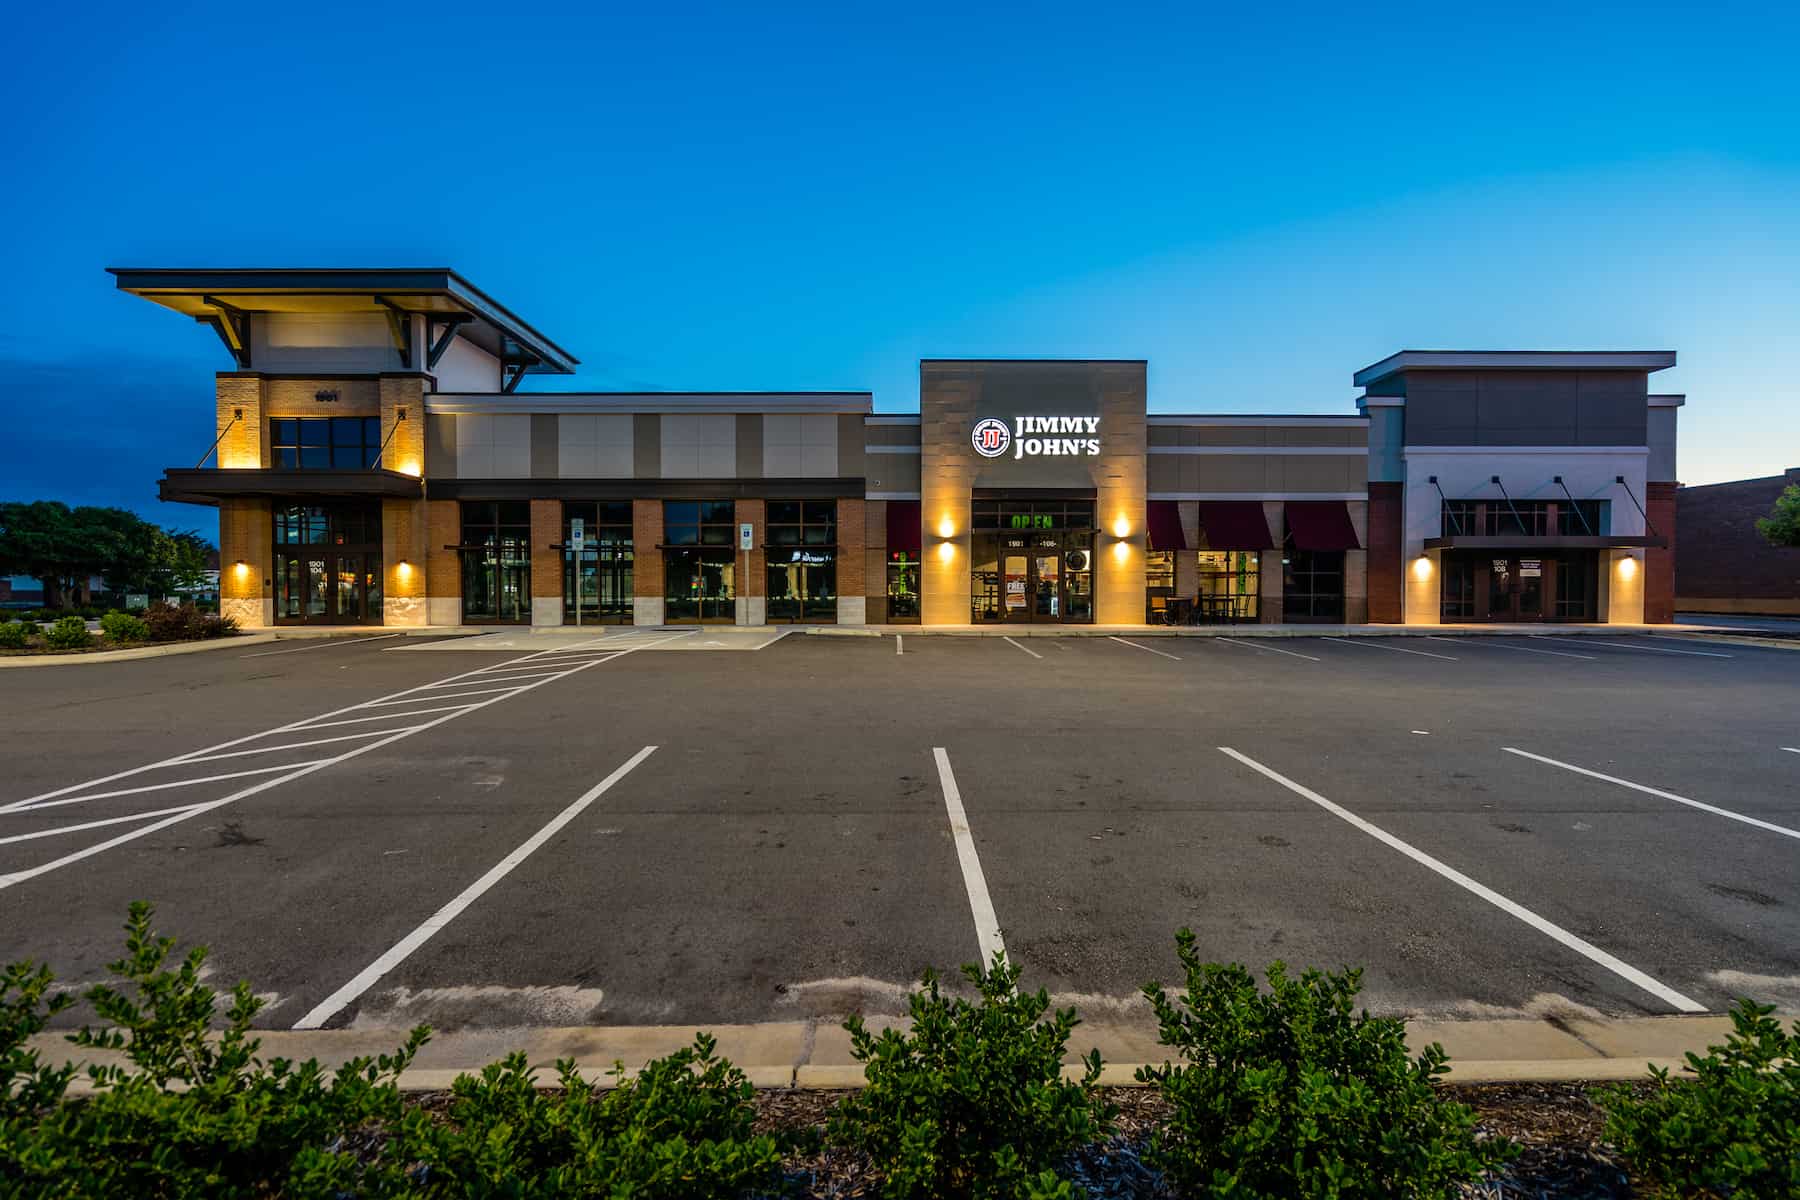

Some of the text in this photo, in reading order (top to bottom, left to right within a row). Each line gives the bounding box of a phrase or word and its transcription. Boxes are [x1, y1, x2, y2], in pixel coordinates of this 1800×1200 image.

[1015, 416, 1100, 437] JIMMY
[982, 429, 1001, 449] JJ
[1014, 438, 1100, 460] JOHN'S
[1011, 515, 1053, 529] OPEN
